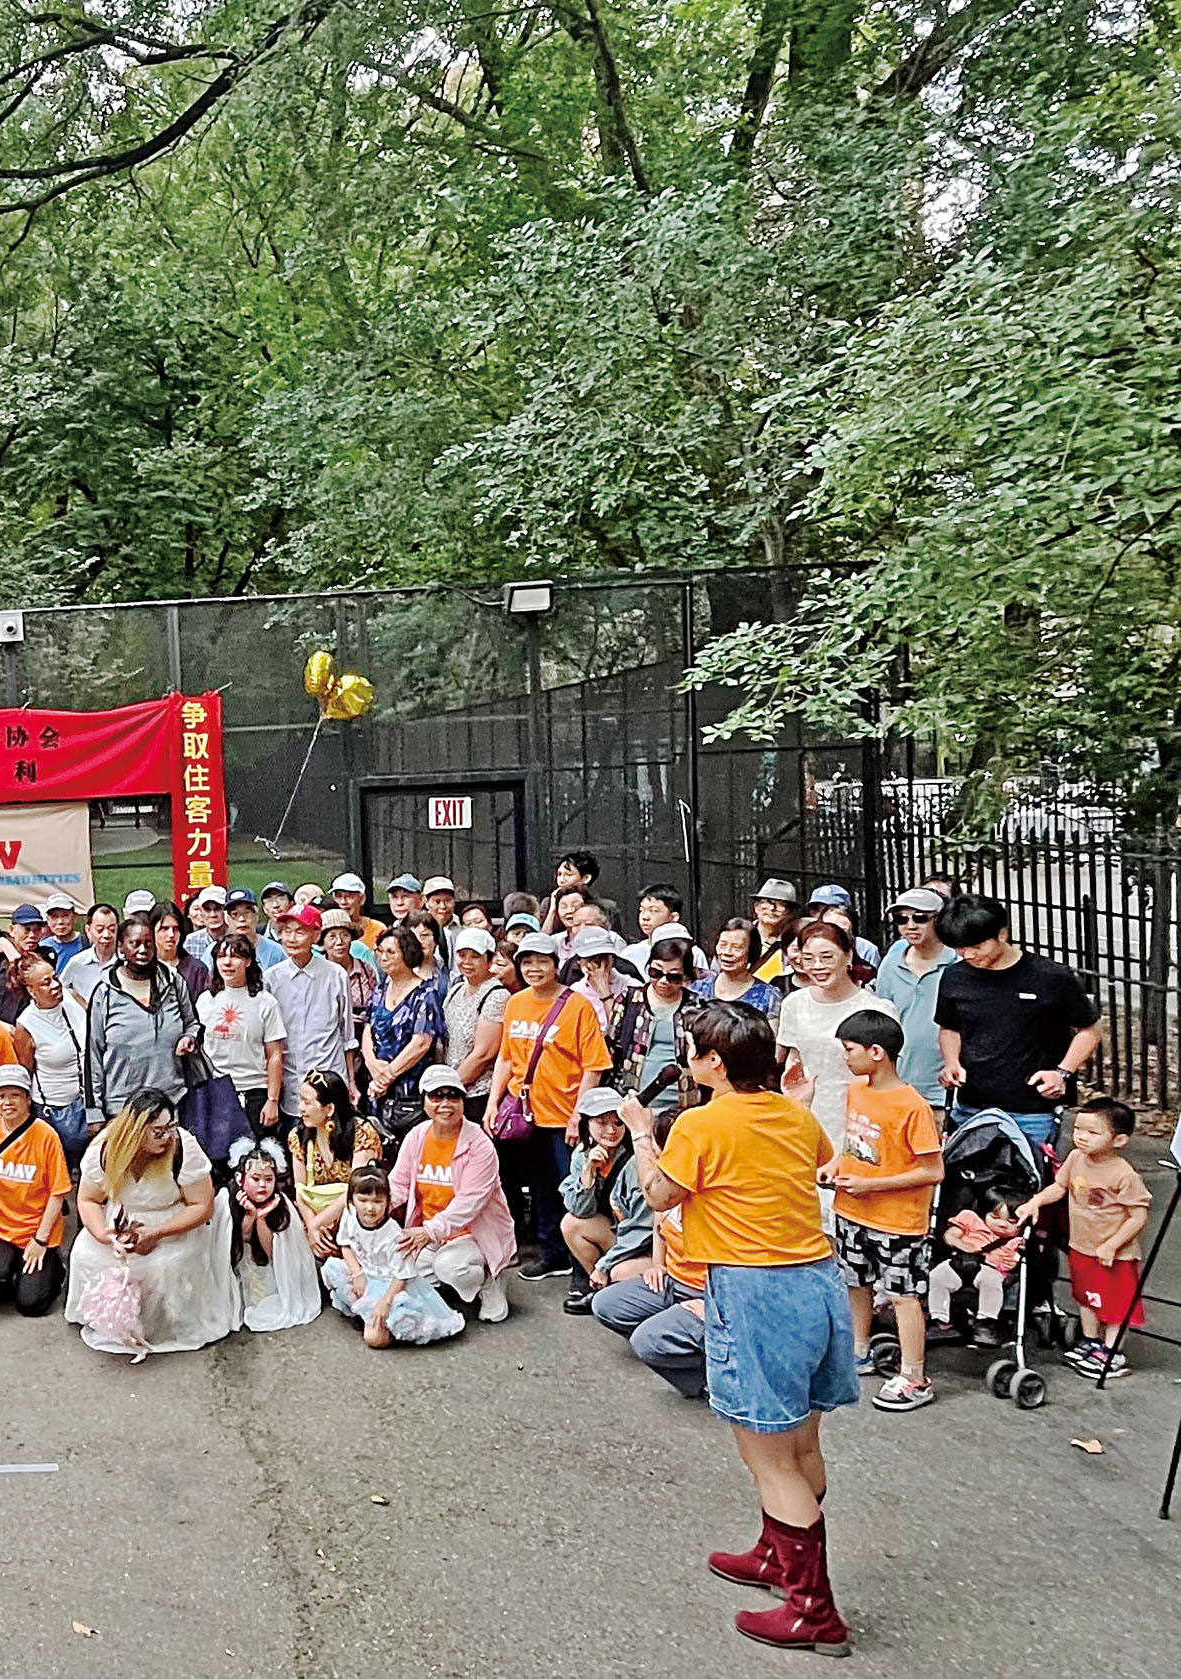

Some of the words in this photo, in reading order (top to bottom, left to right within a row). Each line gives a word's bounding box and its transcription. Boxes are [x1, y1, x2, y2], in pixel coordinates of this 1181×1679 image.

[180, 701, 214, 889] 争取住客力量
[435, 800, 465, 826] EXIT
